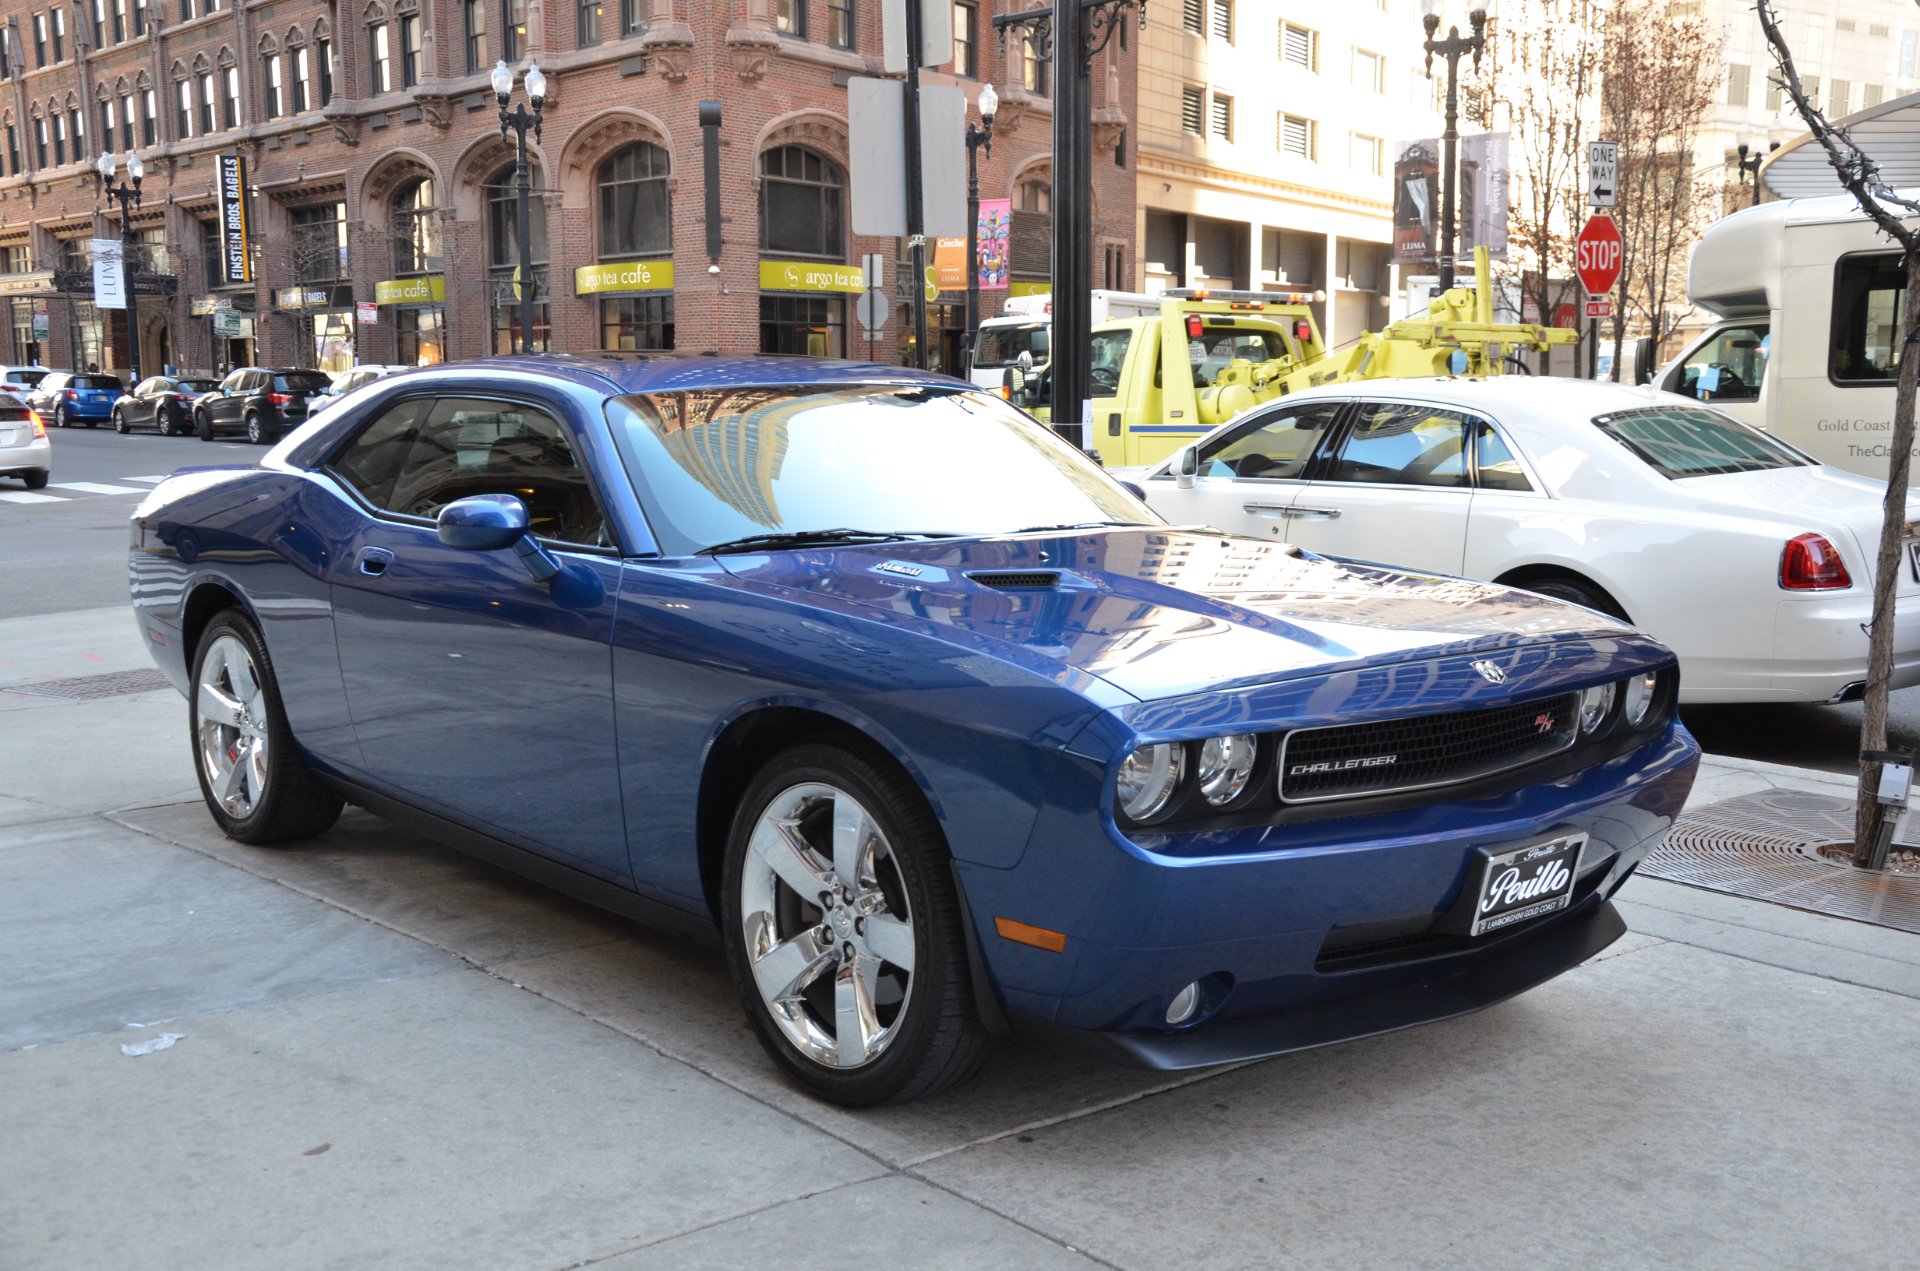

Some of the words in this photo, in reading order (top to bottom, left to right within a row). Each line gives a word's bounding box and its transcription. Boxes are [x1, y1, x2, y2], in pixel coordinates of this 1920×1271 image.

[1592, 147, 1613, 163] ONE
[224, 158, 240, 199] BAGELS
[1592, 165, 1614, 181] WAY
[227, 202, 241, 230] BROS.
[229, 233, 244, 280] EINSTEIN
[1402, 242, 1426, 250] LUMA
[1579, 240, 1620, 270] STOP
[101, 249, 116, 296] LUMA
[603, 272, 617, 285] tea
[621, 263, 651, 284] café
[805, 271, 832, 289] argo
[835, 271, 848, 286] tea
[404, 280, 428, 298] café
[1817, 419, 1849, 431] Gold
[1853, 419, 1891, 431] Coast
[1290, 755, 1397, 775] CHALLENGER
[1481, 859, 1570, 912] Perillo
[1487, 912, 1524, 929] LAMBORGHINI
[1524, 907, 1539, 918] GOLD
[1540, 902, 1557, 912] COAST
